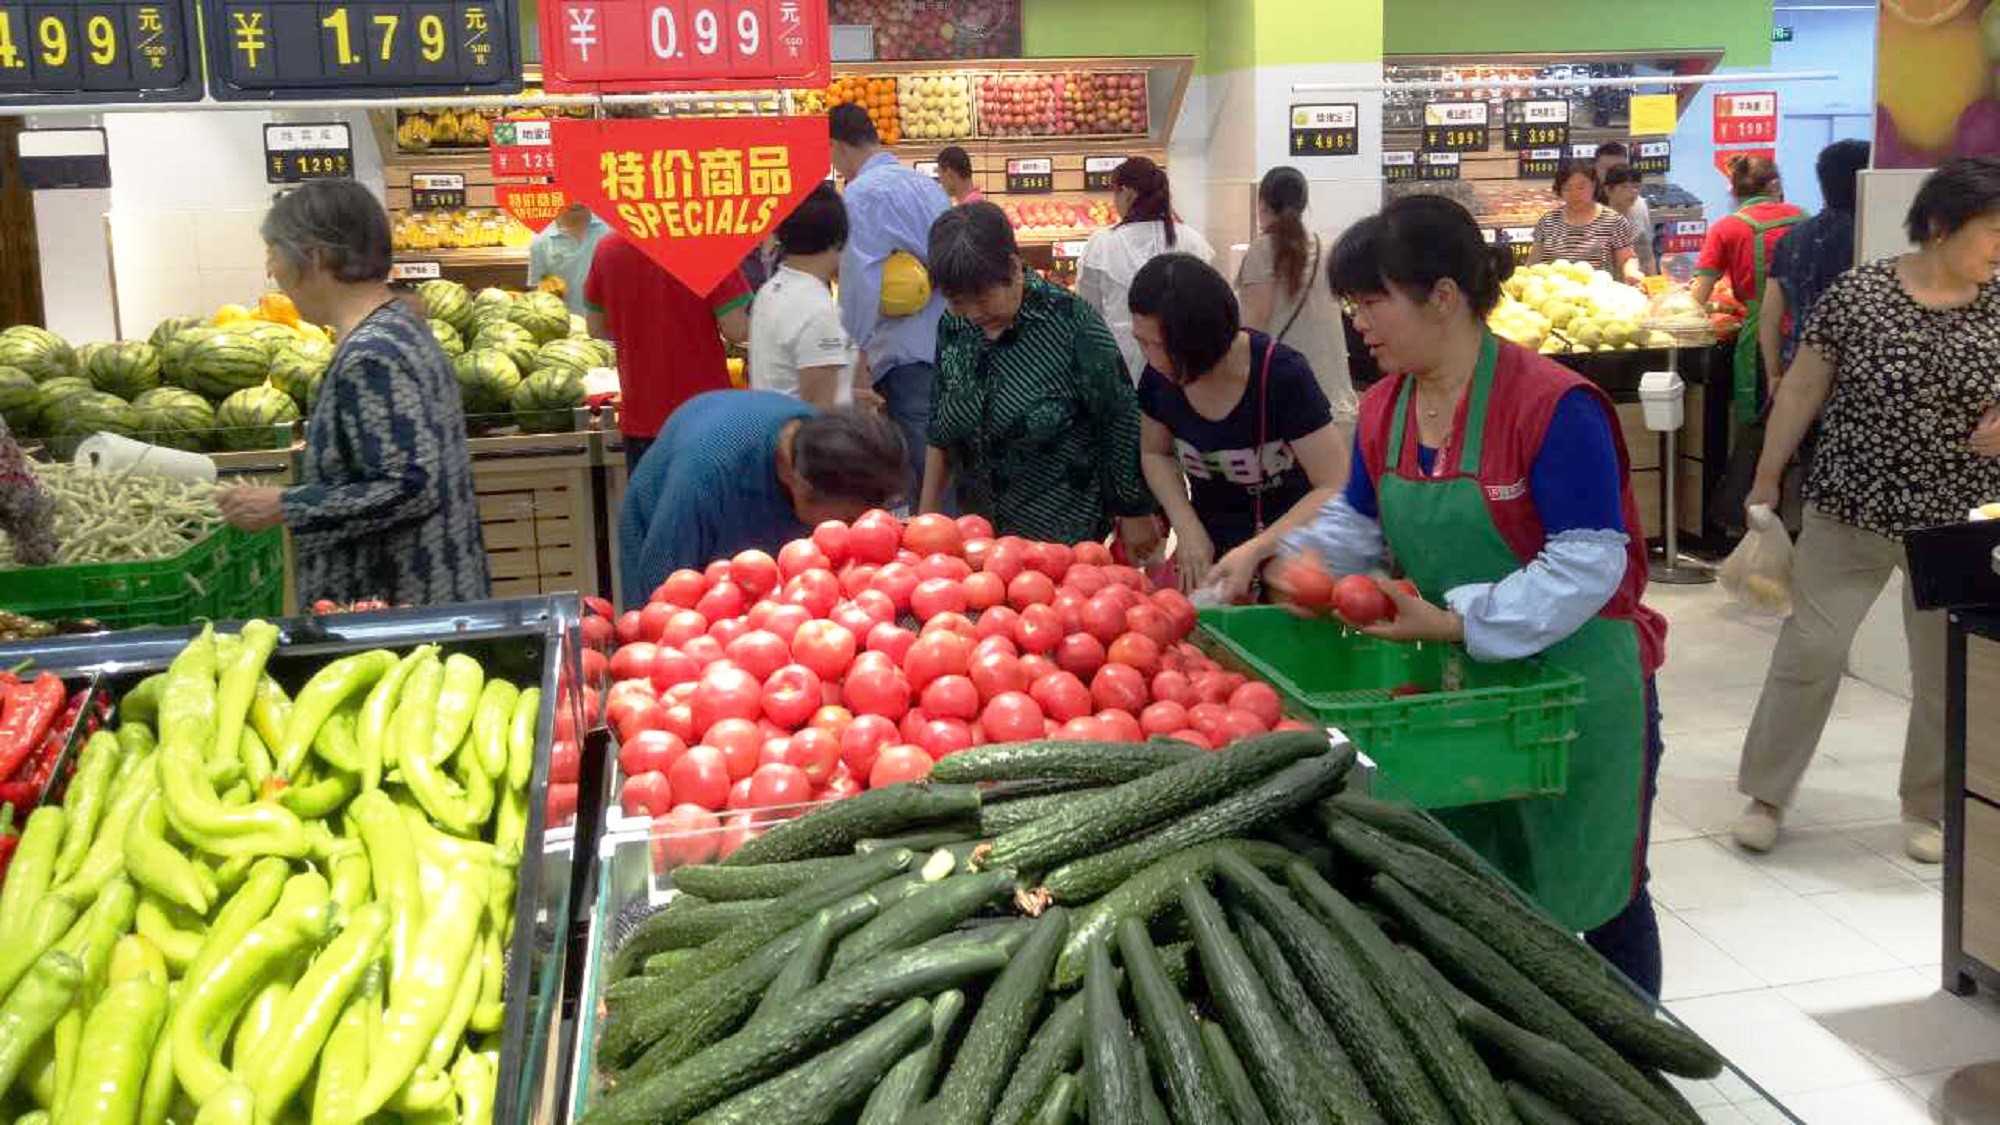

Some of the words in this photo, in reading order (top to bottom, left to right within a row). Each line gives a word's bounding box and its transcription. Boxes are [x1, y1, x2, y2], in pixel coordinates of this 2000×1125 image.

[322, 8, 445, 64] 1.79
[651, 7, 760, 58] 0.99
[600, 146, 792, 200] 特价商品
[616, 197, 778, 238] SPECIALS
